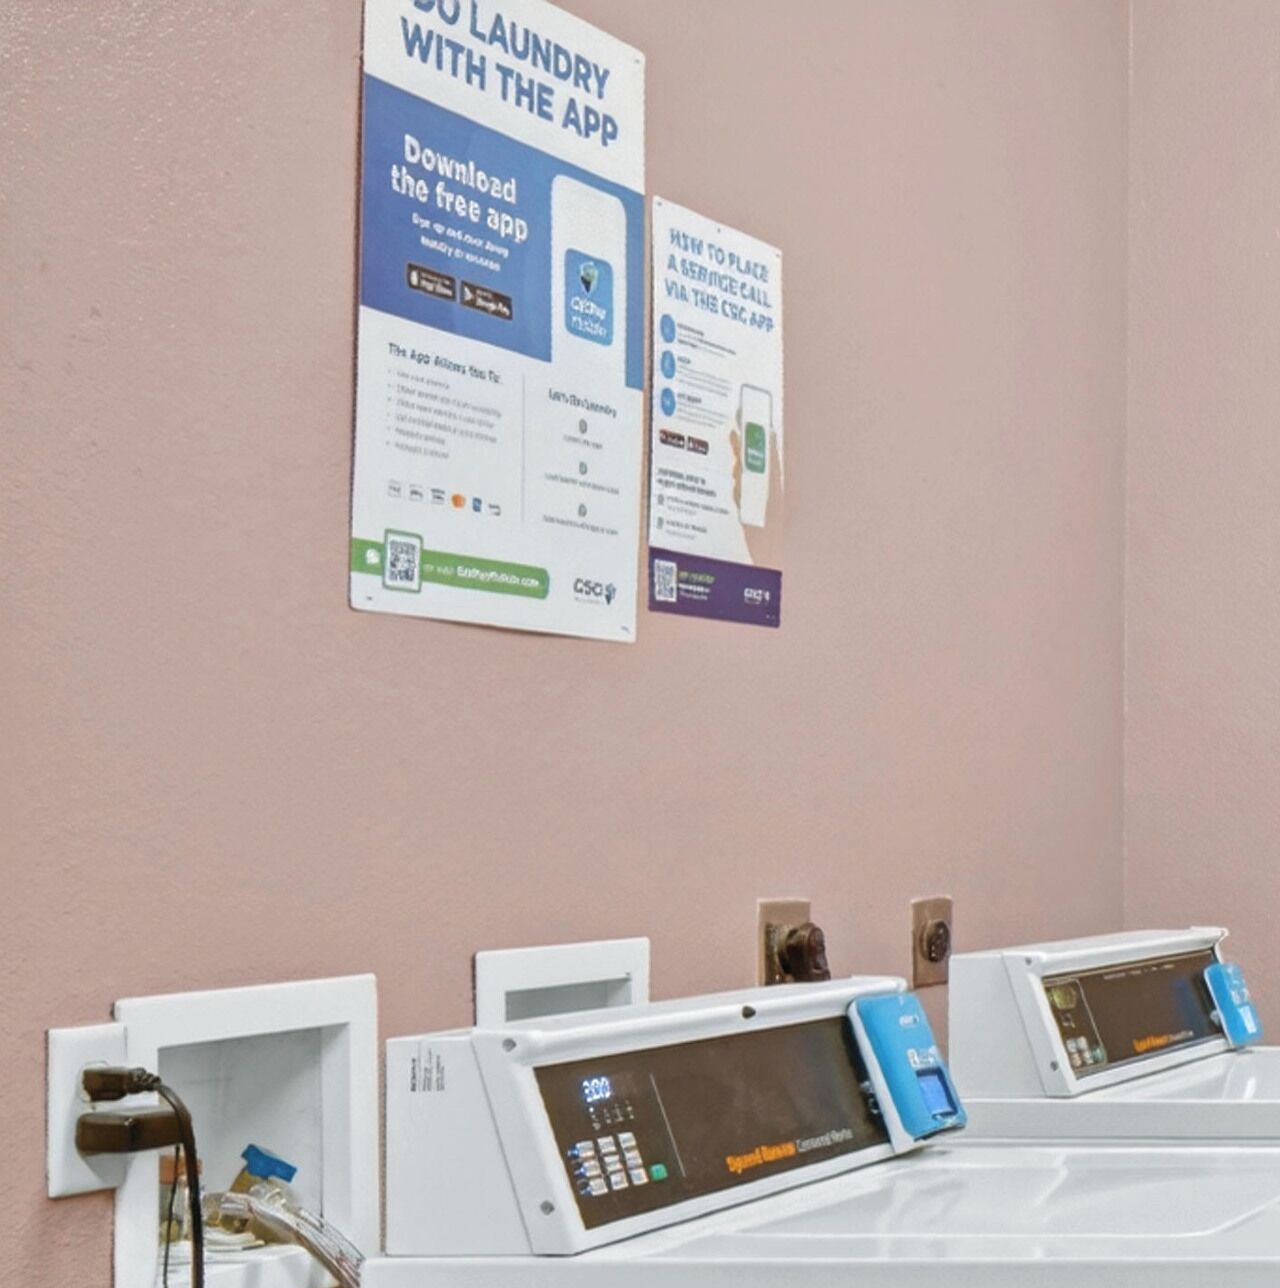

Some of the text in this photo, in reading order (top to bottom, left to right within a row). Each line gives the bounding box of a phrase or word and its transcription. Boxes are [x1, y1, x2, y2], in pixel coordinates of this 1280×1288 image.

[401, 16, 618, 147] WITH THE APP
[470, 0, 610, 100] LAUNDRY
[391, 164, 528, 243] the free app
[404, 134, 517, 204] Download
[667, 253, 679, 273] A
[740, 282, 773, 308] CALL
[707, 243, 725, 266] TO
[728, 252, 768, 283] PLACE
[664, 277, 688, 302] VIA
[692, 288, 719, 314] THE
[749, 311, 774, 332] APP
